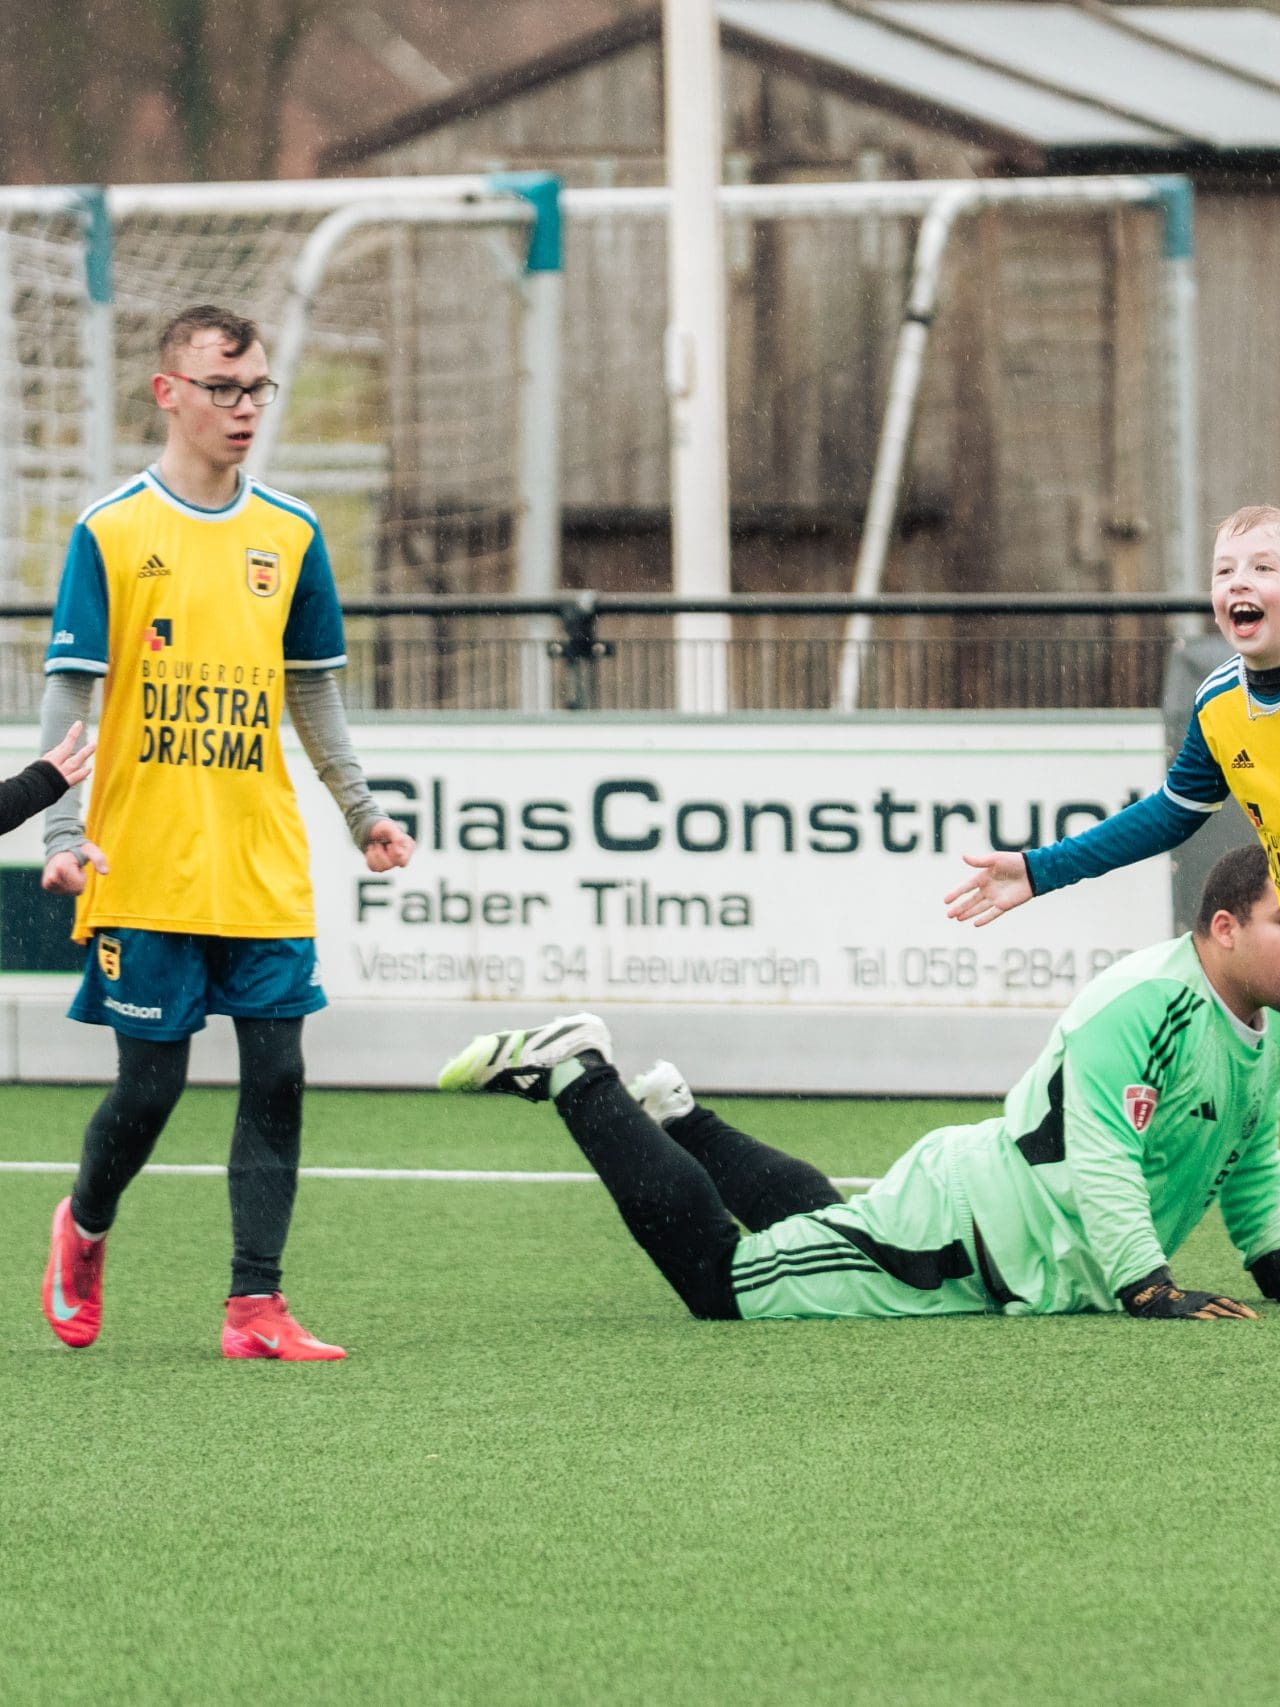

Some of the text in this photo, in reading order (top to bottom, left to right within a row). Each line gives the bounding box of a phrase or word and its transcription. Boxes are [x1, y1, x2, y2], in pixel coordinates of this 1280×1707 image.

[138, 725, 264, 773] DRAISMA
[364, 776, 1141, 852] GlasConstruc
[355, 880, 752, 927] Faber Tilma
[356, 945, 526, 994] Vestaweg
[539, 945, 588, 985] 34
[606, 945, 820, 987] Leeuwarden
